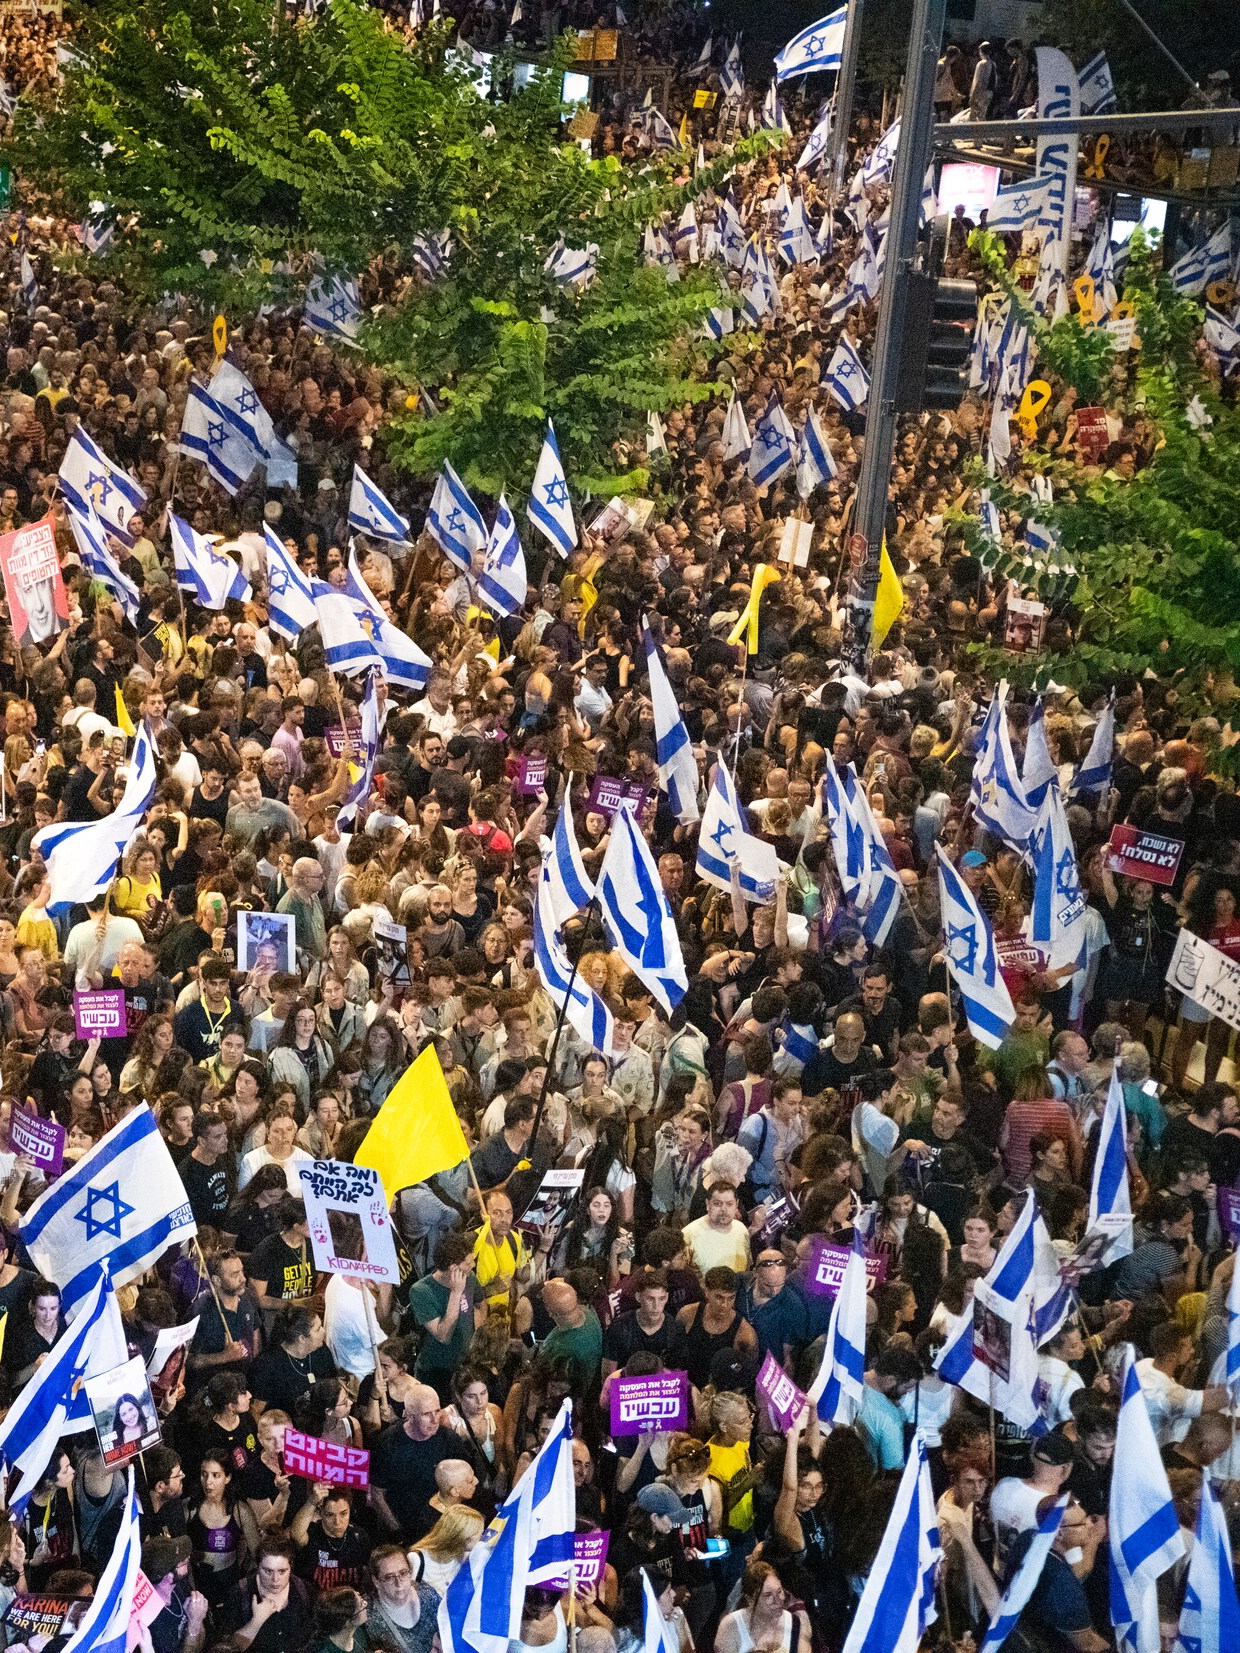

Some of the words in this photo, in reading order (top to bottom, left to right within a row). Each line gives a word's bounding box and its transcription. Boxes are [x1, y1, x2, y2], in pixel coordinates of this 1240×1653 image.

[22, 525, 50, 543] הצביע:
[26, 550, 39, 565] דין
[40, 546, 54, 558] גזר
[8, 555, 26, 570] מוות
[22, 562, 58, 586] לחטופים
[528, 773, 544, 784] שיו
[1138, 836, 1166, 851] נשכח,
[1168, 843, 1180, 854] לא
[1122, 843, 1155, 863] נסלח!
[1158, 855, 1176, 868] לא
[78, 996, 96, 1004] העסקה
[104, 994, 118, 1002] לקבל
[82, 1013, 116, 1024] עכשיו
[14, 1109, 31, 1125] העסקה
[32, 1120, 40, 1129] את
[40, 1132, 56, 1143] לעצור
[42, 1124, 58, 1136] לקבל
[14, 1126, 53, 1158] עכשיו
[313, 1161, 340, 1177] אם
[346, 1166, 378, 1184] ומה
[300, 1170, 346, 1191] הייתם
[312, 1184, 359, 1204] אתם?
[350, 1180, 374, 1198] זה
[168, 1203, 192, 1220] חופשי
[822, 1248, 848, 1260] העסקה
[284, 1265, 298, 1280] GET
[326, 1256, 388, 1276] KIDNAPPED
[284, 1276, 313, 1292] PEOLE
[619, 1383, 646, 1392] העסקה
[648, 1382, 659, 1390] את
[662, 1378, 681, 1388] לקבל
[619, 1392, 646, 1400] המלחמה
[648, 1390, 658, 1398] את
[661, 1388, 681, 1397] לעצור
[624, 1400, 676, 1417] עכשיו
[286, 1429, 368, 1466] קבינט
[285, 1450, 368, 1486] המוות
[584, 1538, 603, 1549] לקבל
[584, 1549, 601, 1558] לעצור
[134, 1582, 153, 1608] NOW
[14, 1598, 68, 1616] KARINA
[10, 1608, 24, 1618] WE
[24, 1610, 41, 1622] ARE
[41, 1613, 63, 1624] HERE
[6, 1614, 31, 1630] FOR
[32, 1620, 59, 1636] YOU!
